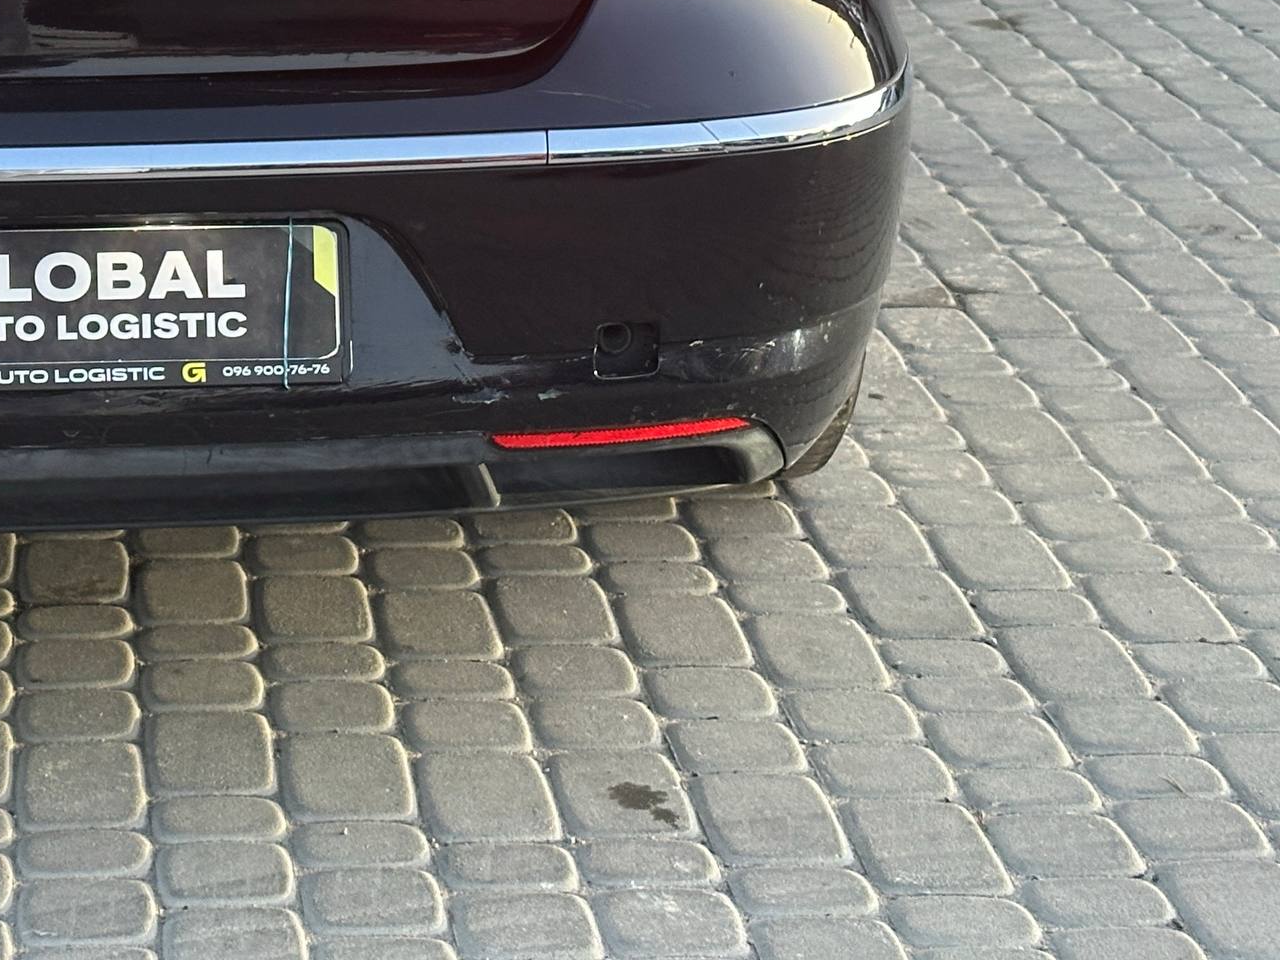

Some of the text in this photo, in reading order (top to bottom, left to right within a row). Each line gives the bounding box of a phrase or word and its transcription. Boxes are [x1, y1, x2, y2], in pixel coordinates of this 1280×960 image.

[56, 310, 249, 341] LOGISTIC
[54, 366, 166, 384] LOGISTIC
[222, 365, 252, 377] 096
